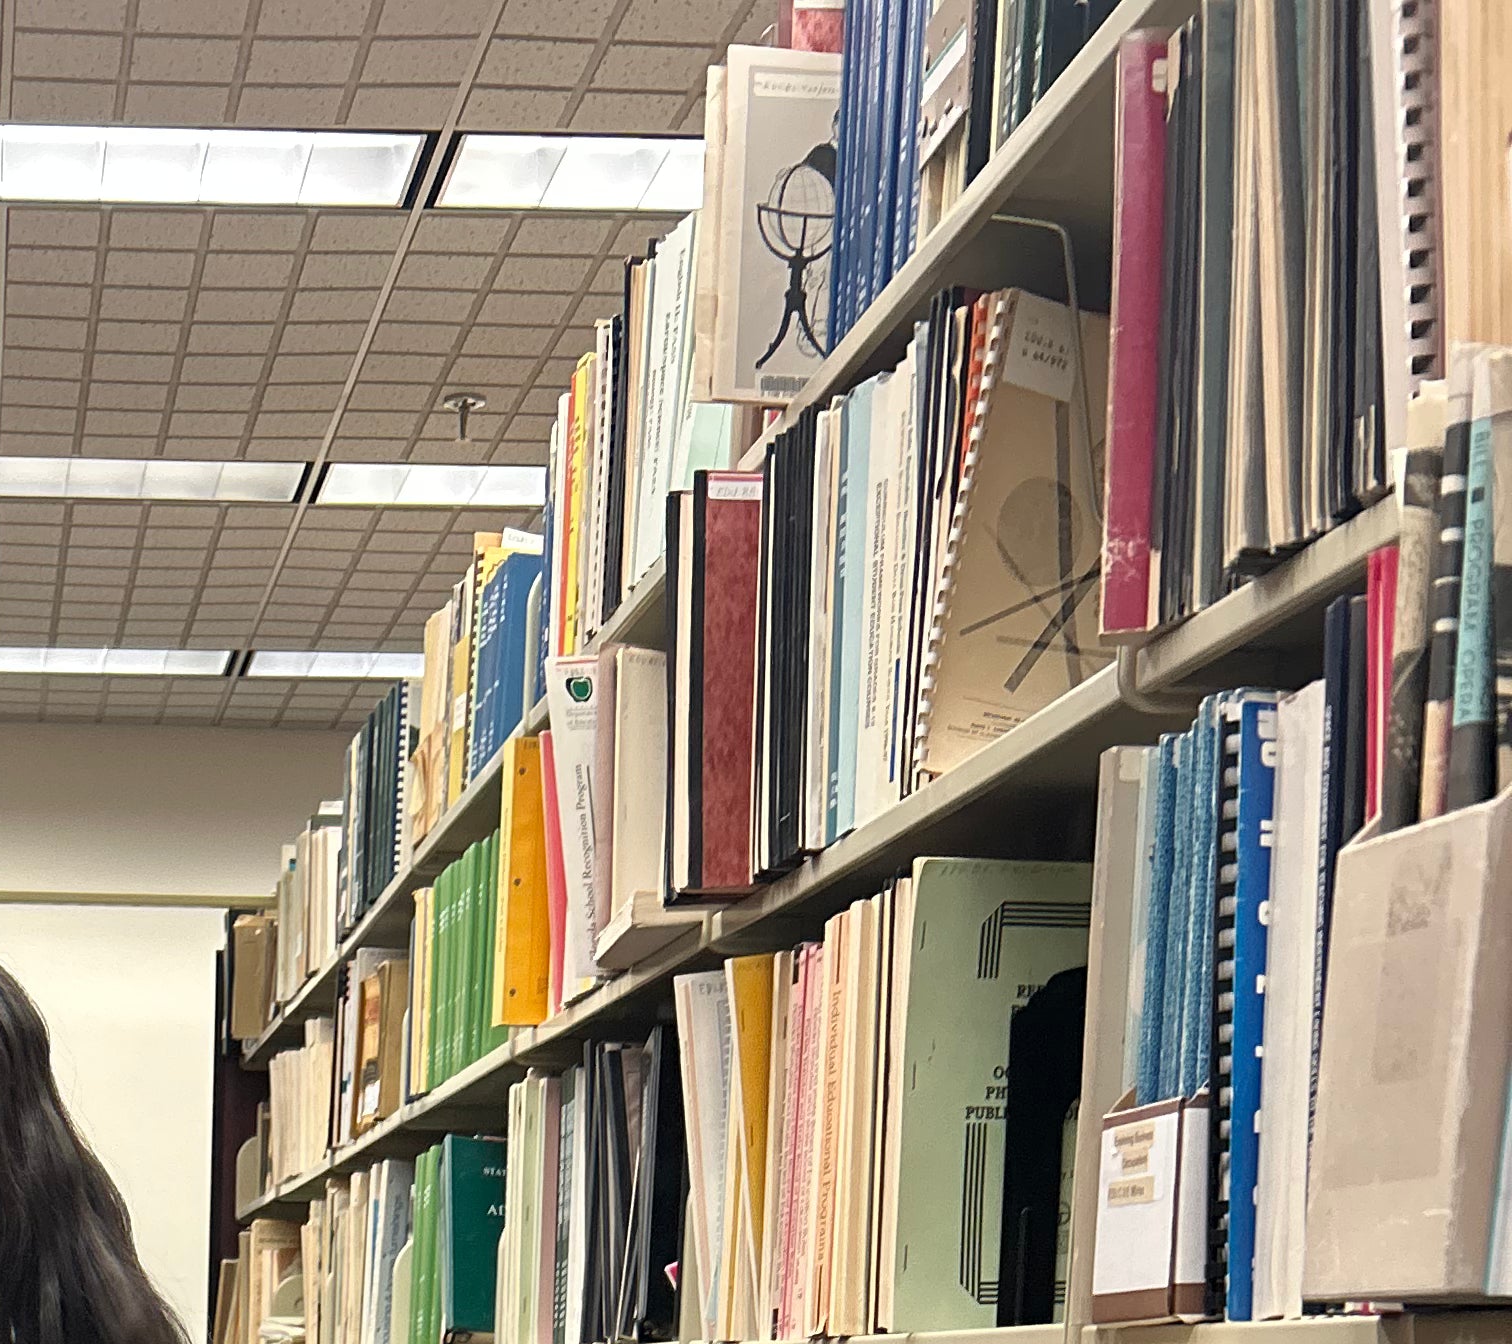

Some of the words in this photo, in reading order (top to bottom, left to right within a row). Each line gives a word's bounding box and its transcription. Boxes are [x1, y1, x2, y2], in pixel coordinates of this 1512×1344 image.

[575, 763, 588, 811] Program
[828, 990, 841, 1077] Individual
[823, 1081, 835, 1176] Educational
[966, 1107, 1008, 1121] PUBLI
[483, 1166, 506, 1177] STAT
[819, 1180, 831, 1266] Programs
